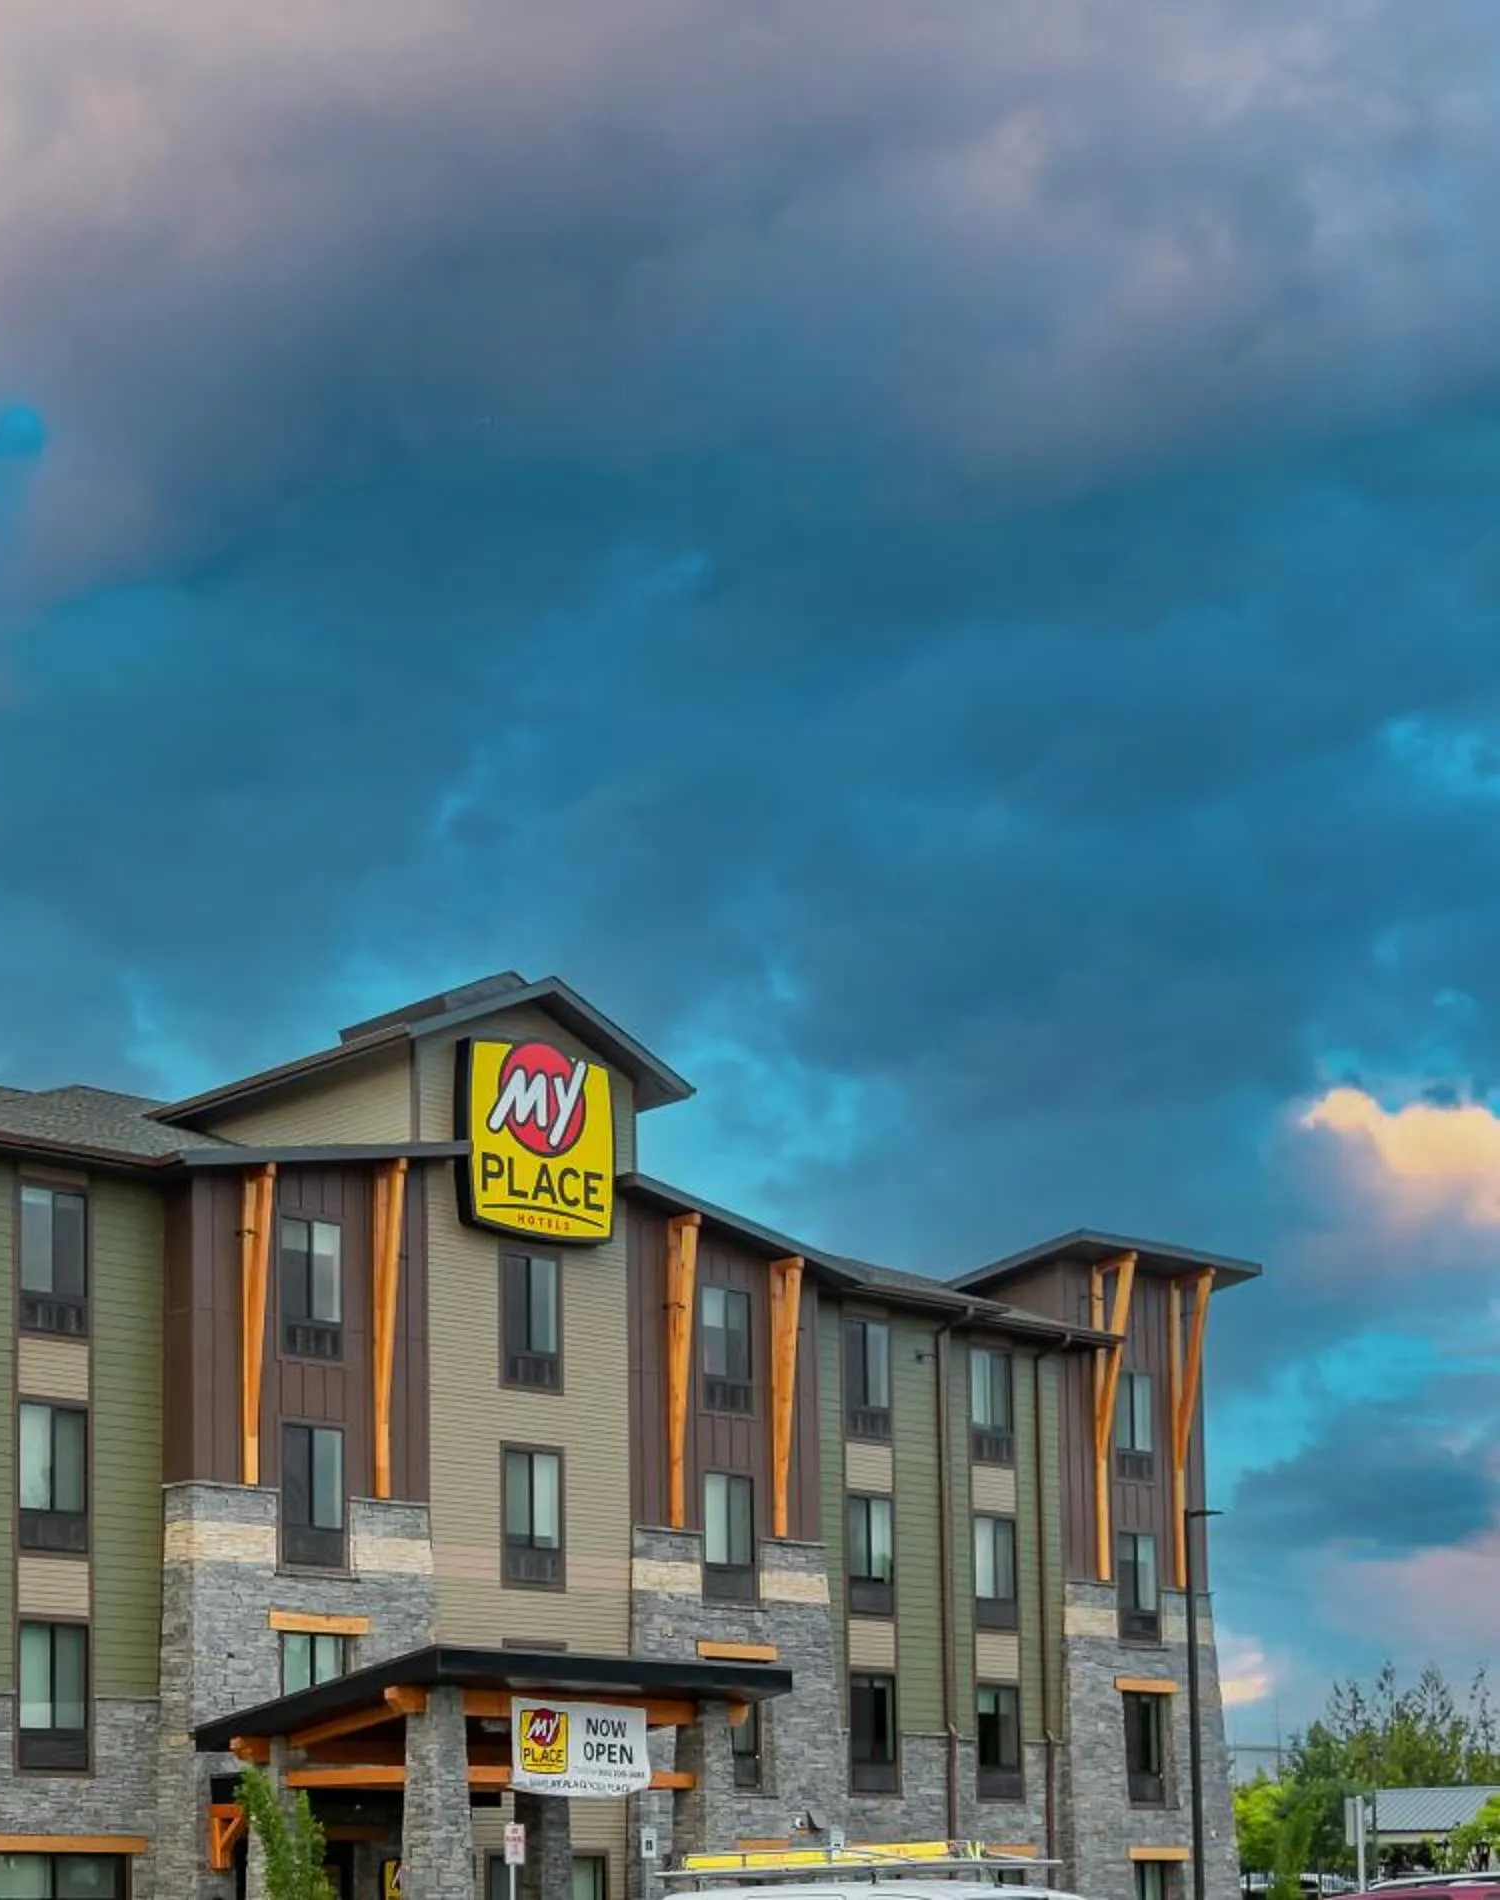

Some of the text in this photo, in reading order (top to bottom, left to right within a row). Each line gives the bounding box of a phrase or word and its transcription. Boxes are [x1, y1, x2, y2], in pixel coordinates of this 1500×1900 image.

[481, 1151, 604, 1213] PLACE
[516, 1213, 571, 1231] HOTELS
[585, 1717, 627, 1739] NOW
[523, 1747, 565, 1763] PLACE
[583, 1741, 634, 1765] OPEN
